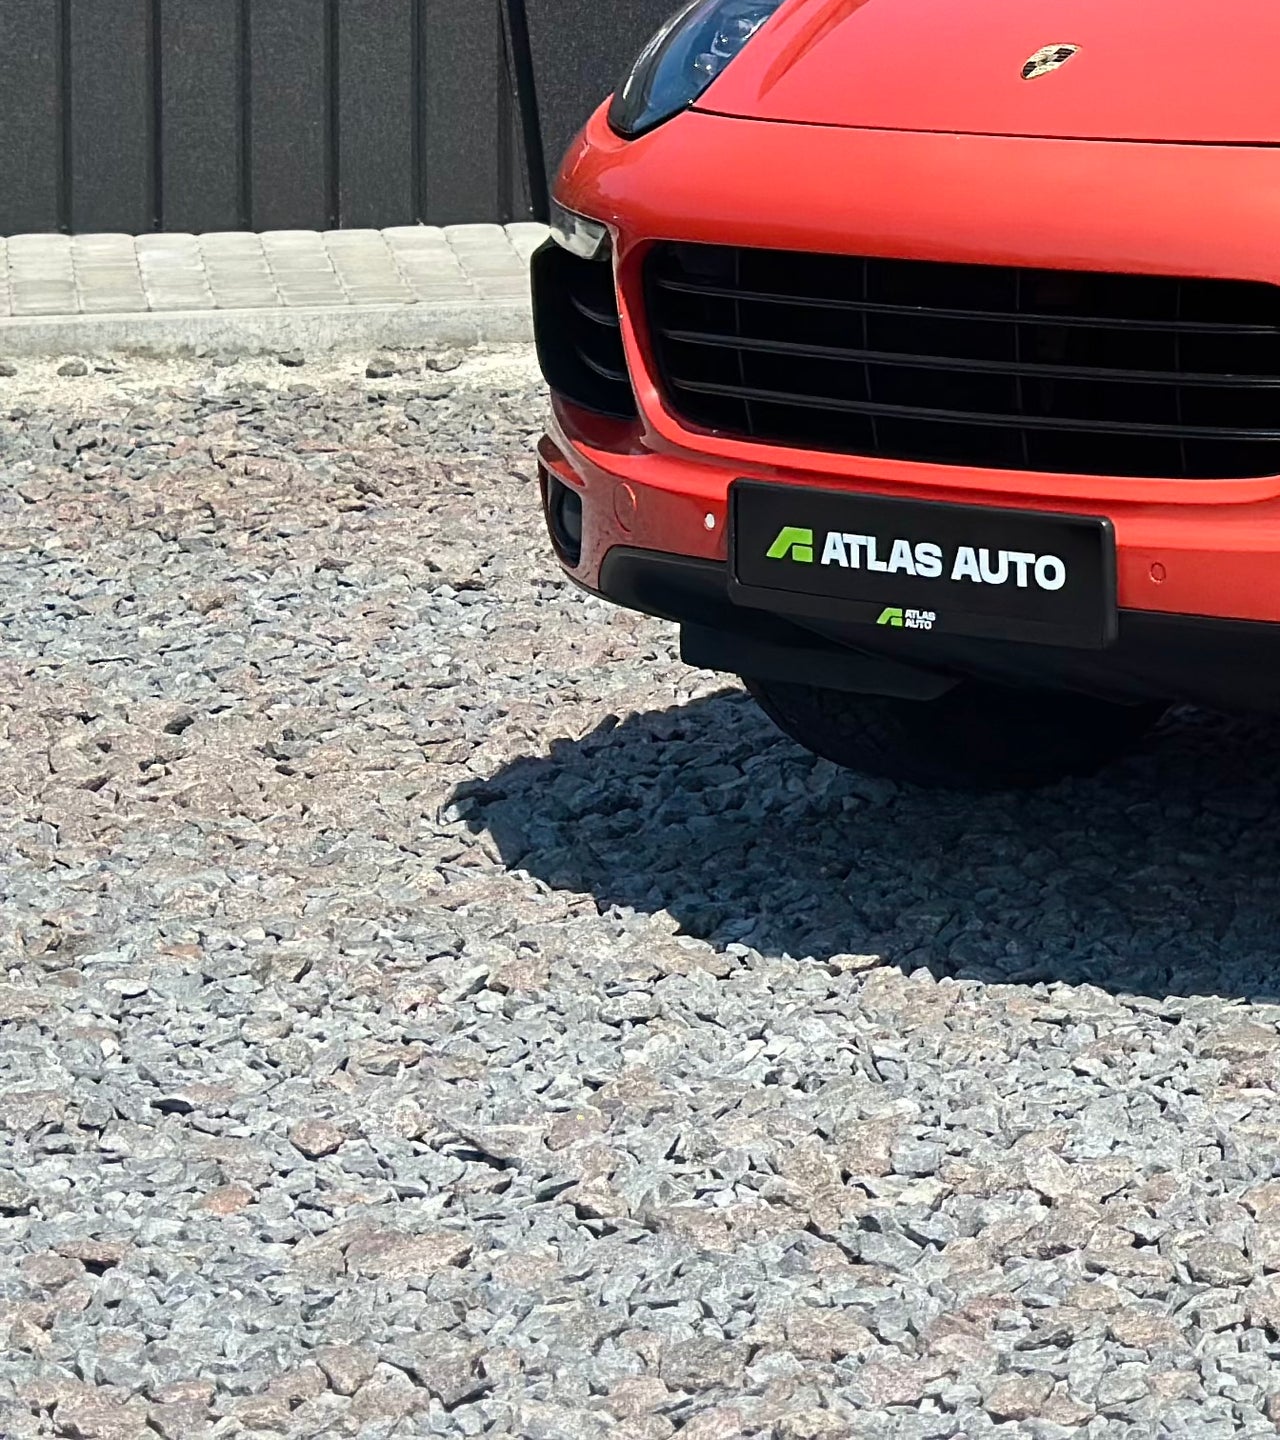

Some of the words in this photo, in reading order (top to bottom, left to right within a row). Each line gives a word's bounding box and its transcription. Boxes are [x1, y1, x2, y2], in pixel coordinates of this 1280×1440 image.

[820, 531, 943, 578] ATLAS
[950, 546, 1067, 591] AUTO
[904, 609, 936, 621] ATLAS
[904, 618, 932, 630] AUTO
